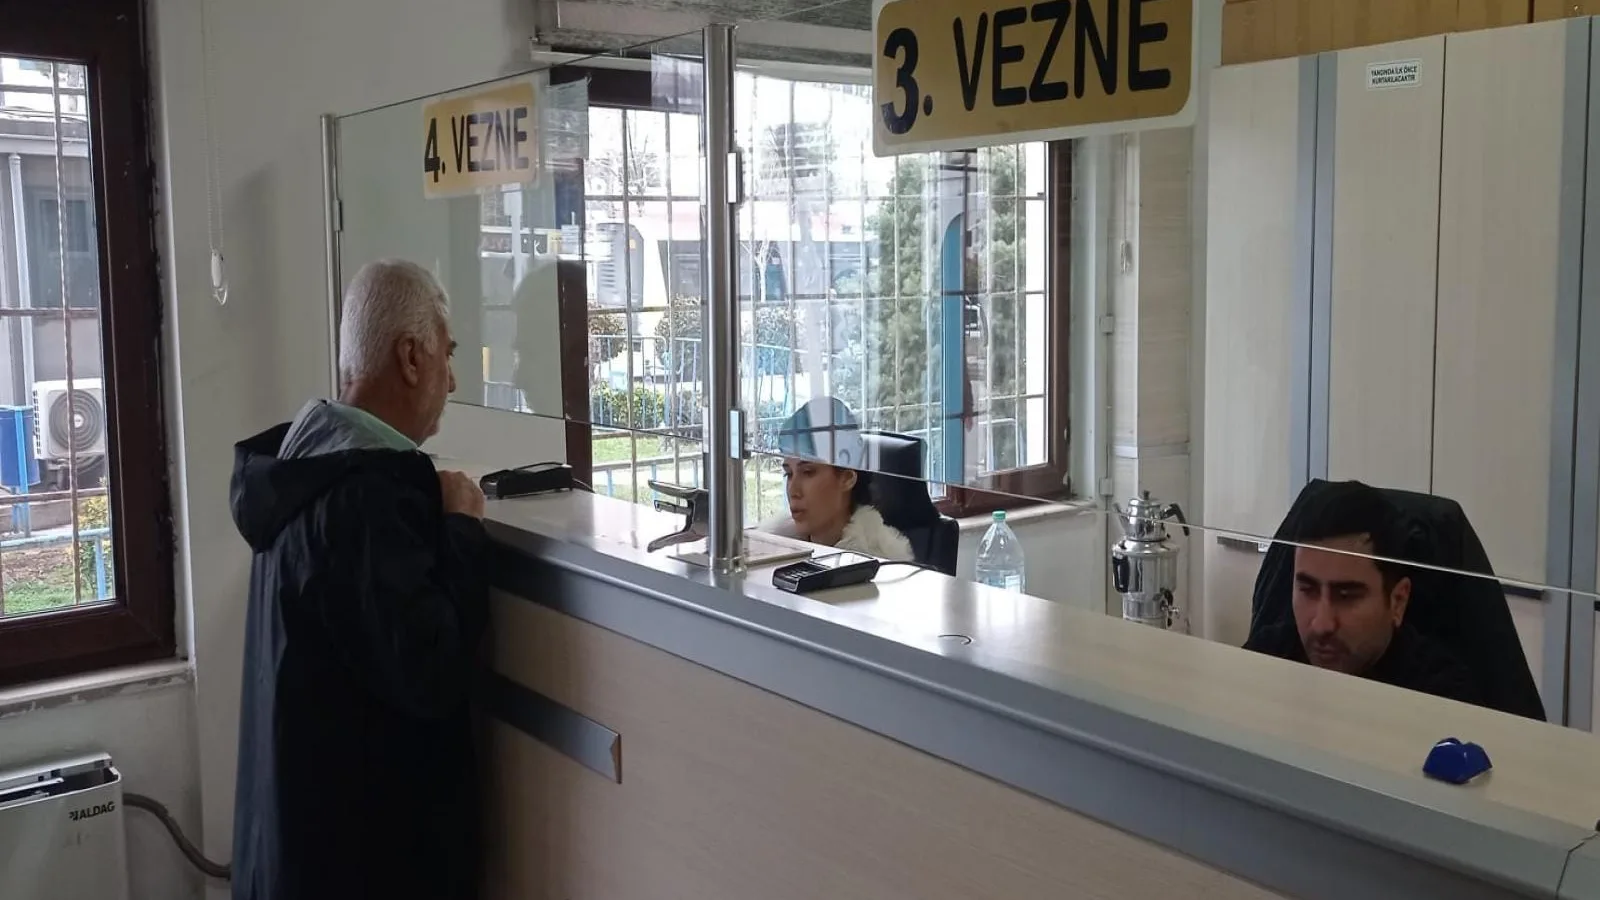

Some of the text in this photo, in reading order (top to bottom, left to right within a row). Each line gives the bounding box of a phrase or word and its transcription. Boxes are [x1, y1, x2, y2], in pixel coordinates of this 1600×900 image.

[881, 0, 1172, 135] 3. VEZNE
[424, 107, 529, 183] 4. VEZNE
